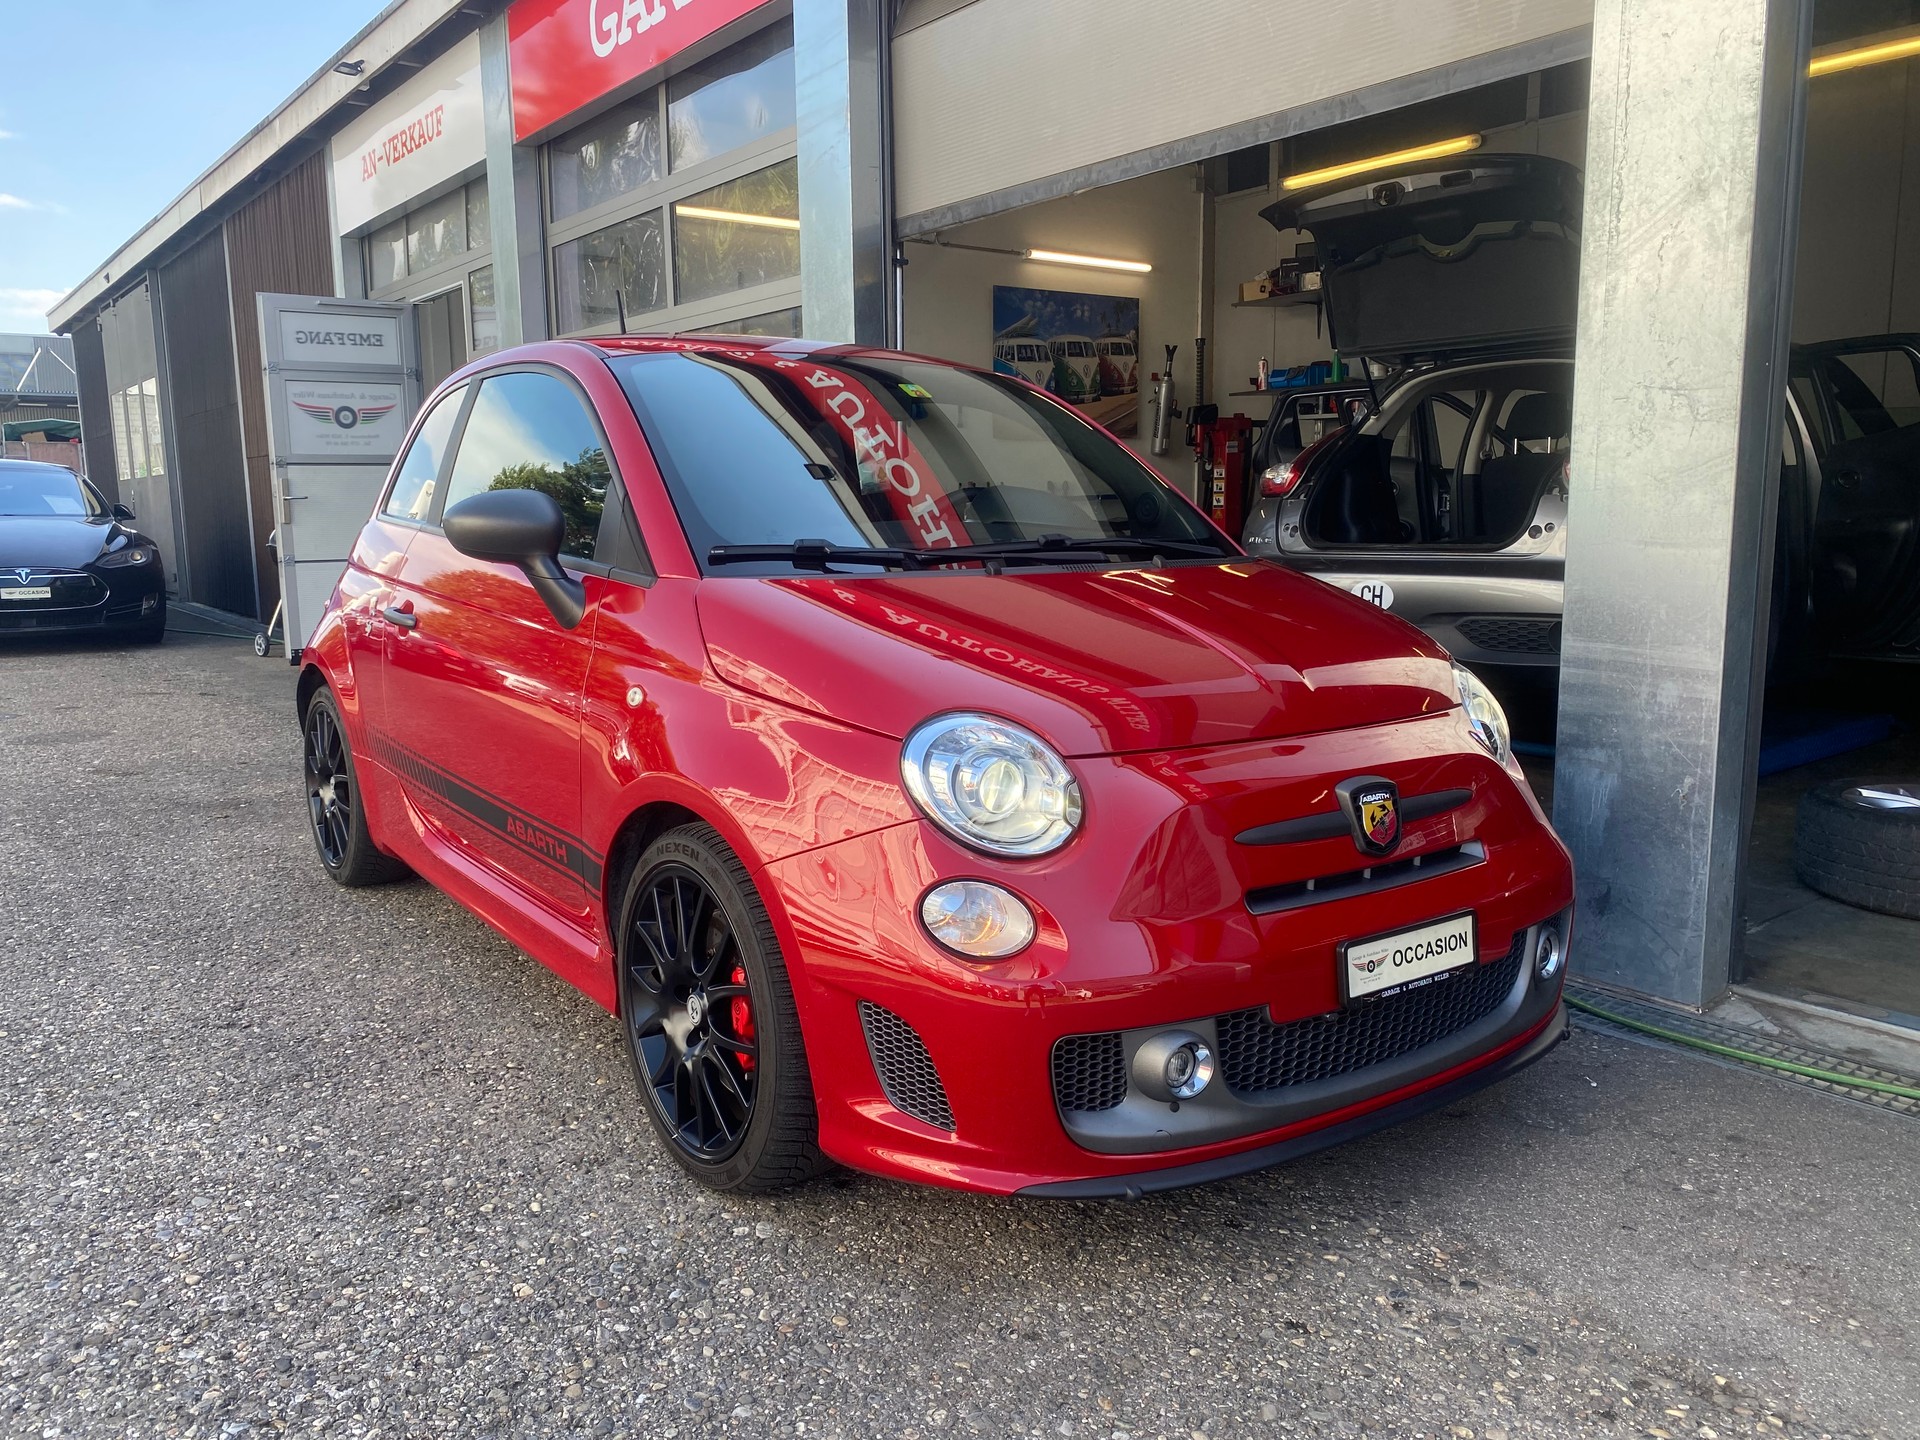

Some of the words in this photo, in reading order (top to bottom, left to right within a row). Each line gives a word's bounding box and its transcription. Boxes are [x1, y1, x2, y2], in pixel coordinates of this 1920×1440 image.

[362, 104, 444, 182] AN-VERKAUF
[1360, 585, 1383, 607] CH
[1363, 793, 1390, 802] ABARTH
[506, 816, 567, 863] ABARTH
[656, 842, 700, 861] NEXEN
[1392, 931, 1468, 967] OCCASION
[1381, 987, 1400, 997] GARAGE
[1434, 972, 1449, 981] WILER
